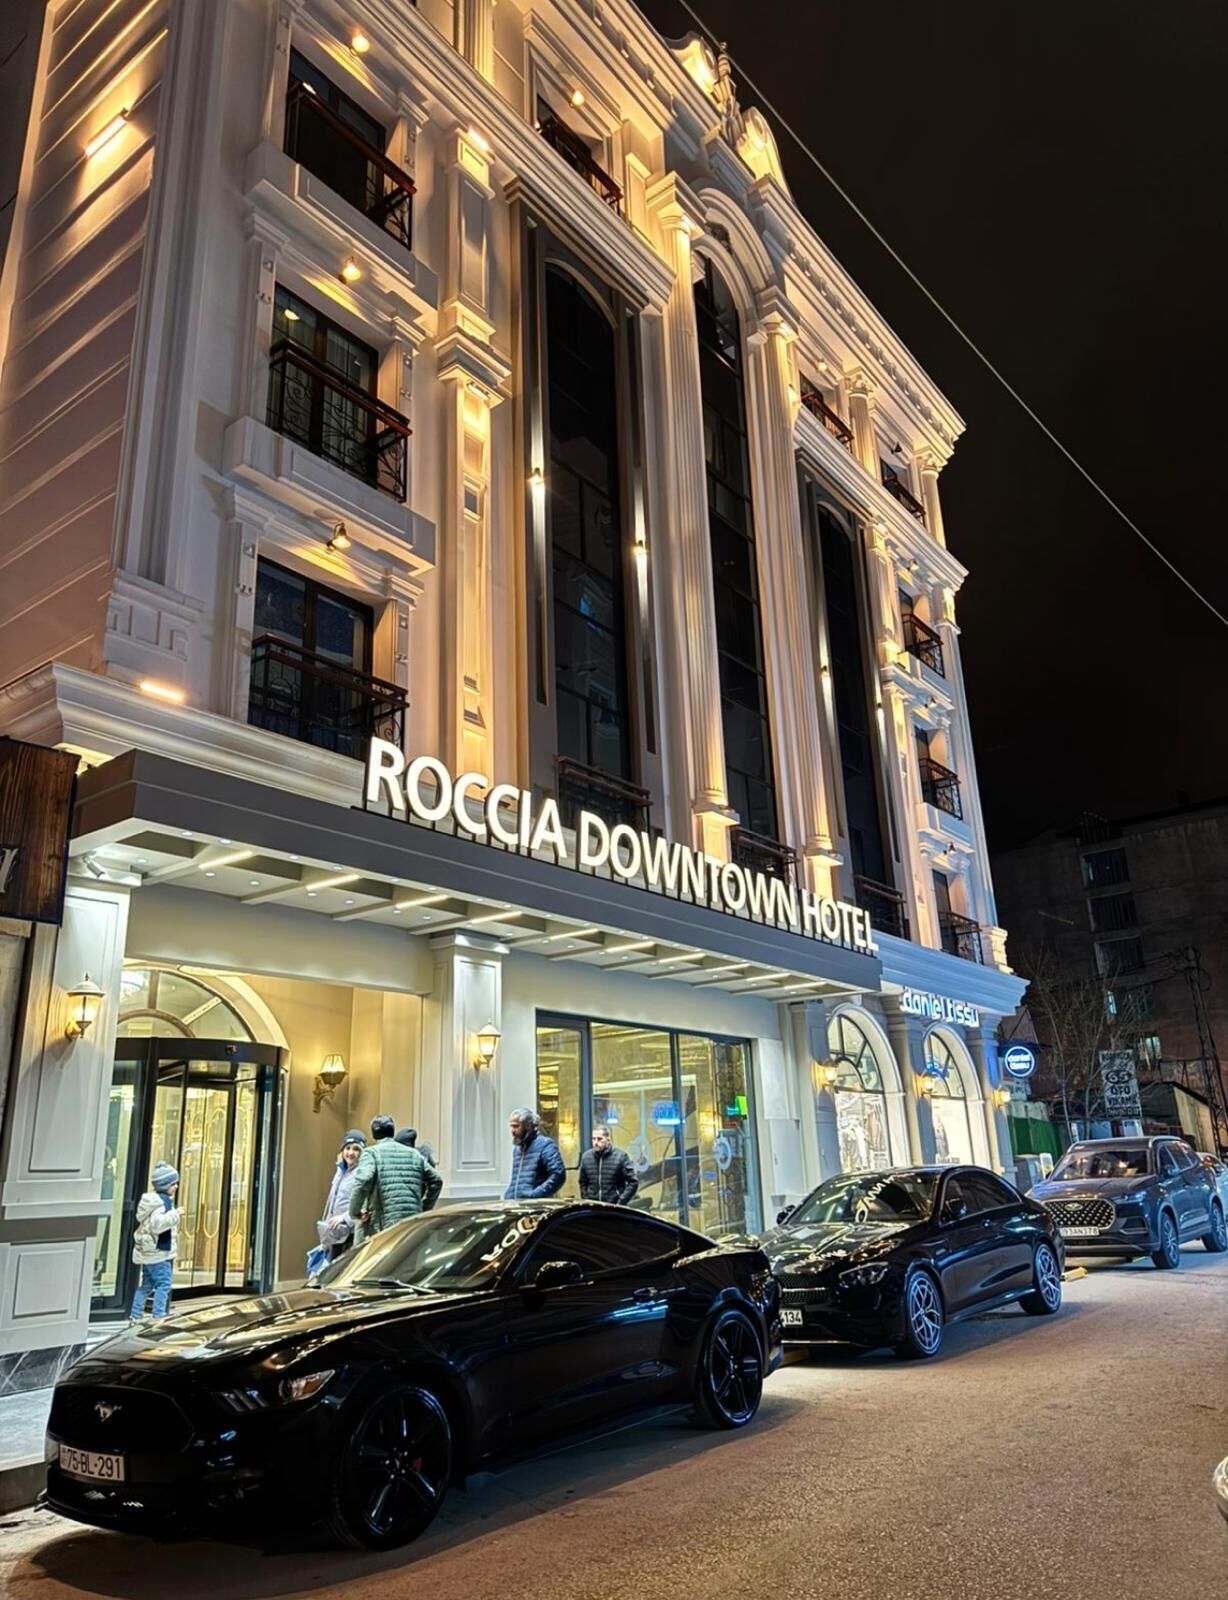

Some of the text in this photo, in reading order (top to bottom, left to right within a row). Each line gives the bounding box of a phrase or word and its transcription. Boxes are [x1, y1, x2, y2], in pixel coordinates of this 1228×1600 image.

[366, 737, 879, 952] ROCCIA DOWNTOWN HOTEL
[902, 988, 980, 1028] daniel tissu
